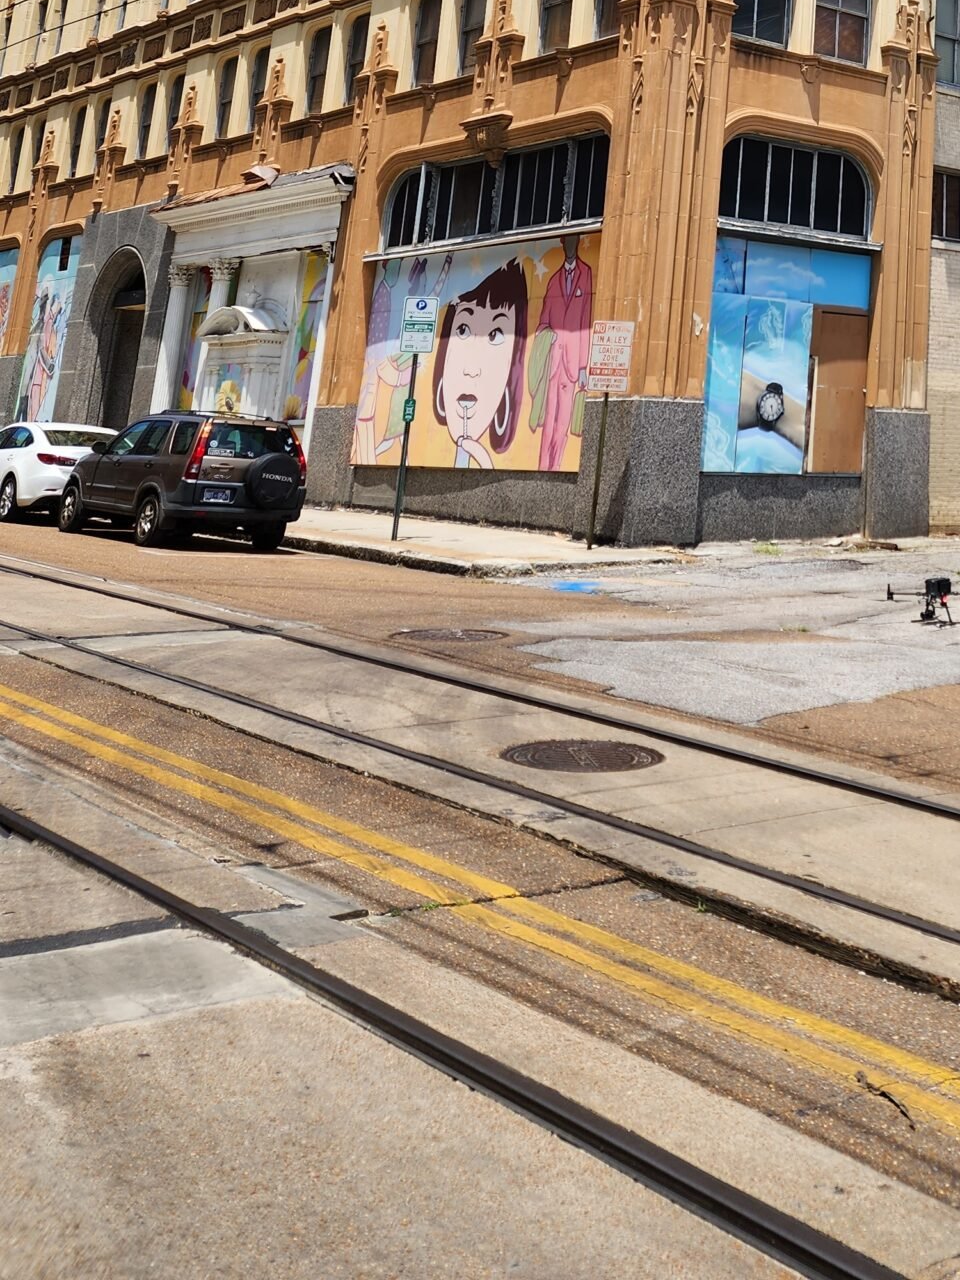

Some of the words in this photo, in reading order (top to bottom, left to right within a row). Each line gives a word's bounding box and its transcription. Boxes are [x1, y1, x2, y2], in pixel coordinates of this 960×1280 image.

[419, 301, 426, 309] P
[595, 323, 606, 333] NO
[607, 325, 631, 333] PARKING
[597, 335, 605, 343] IN
[606, 336, 627, 344] ALEY
[599, 347, 624, 355] LOADING
[602, 354, 618, 362] ZONE
[262, 473, 293, 483] HONDA
